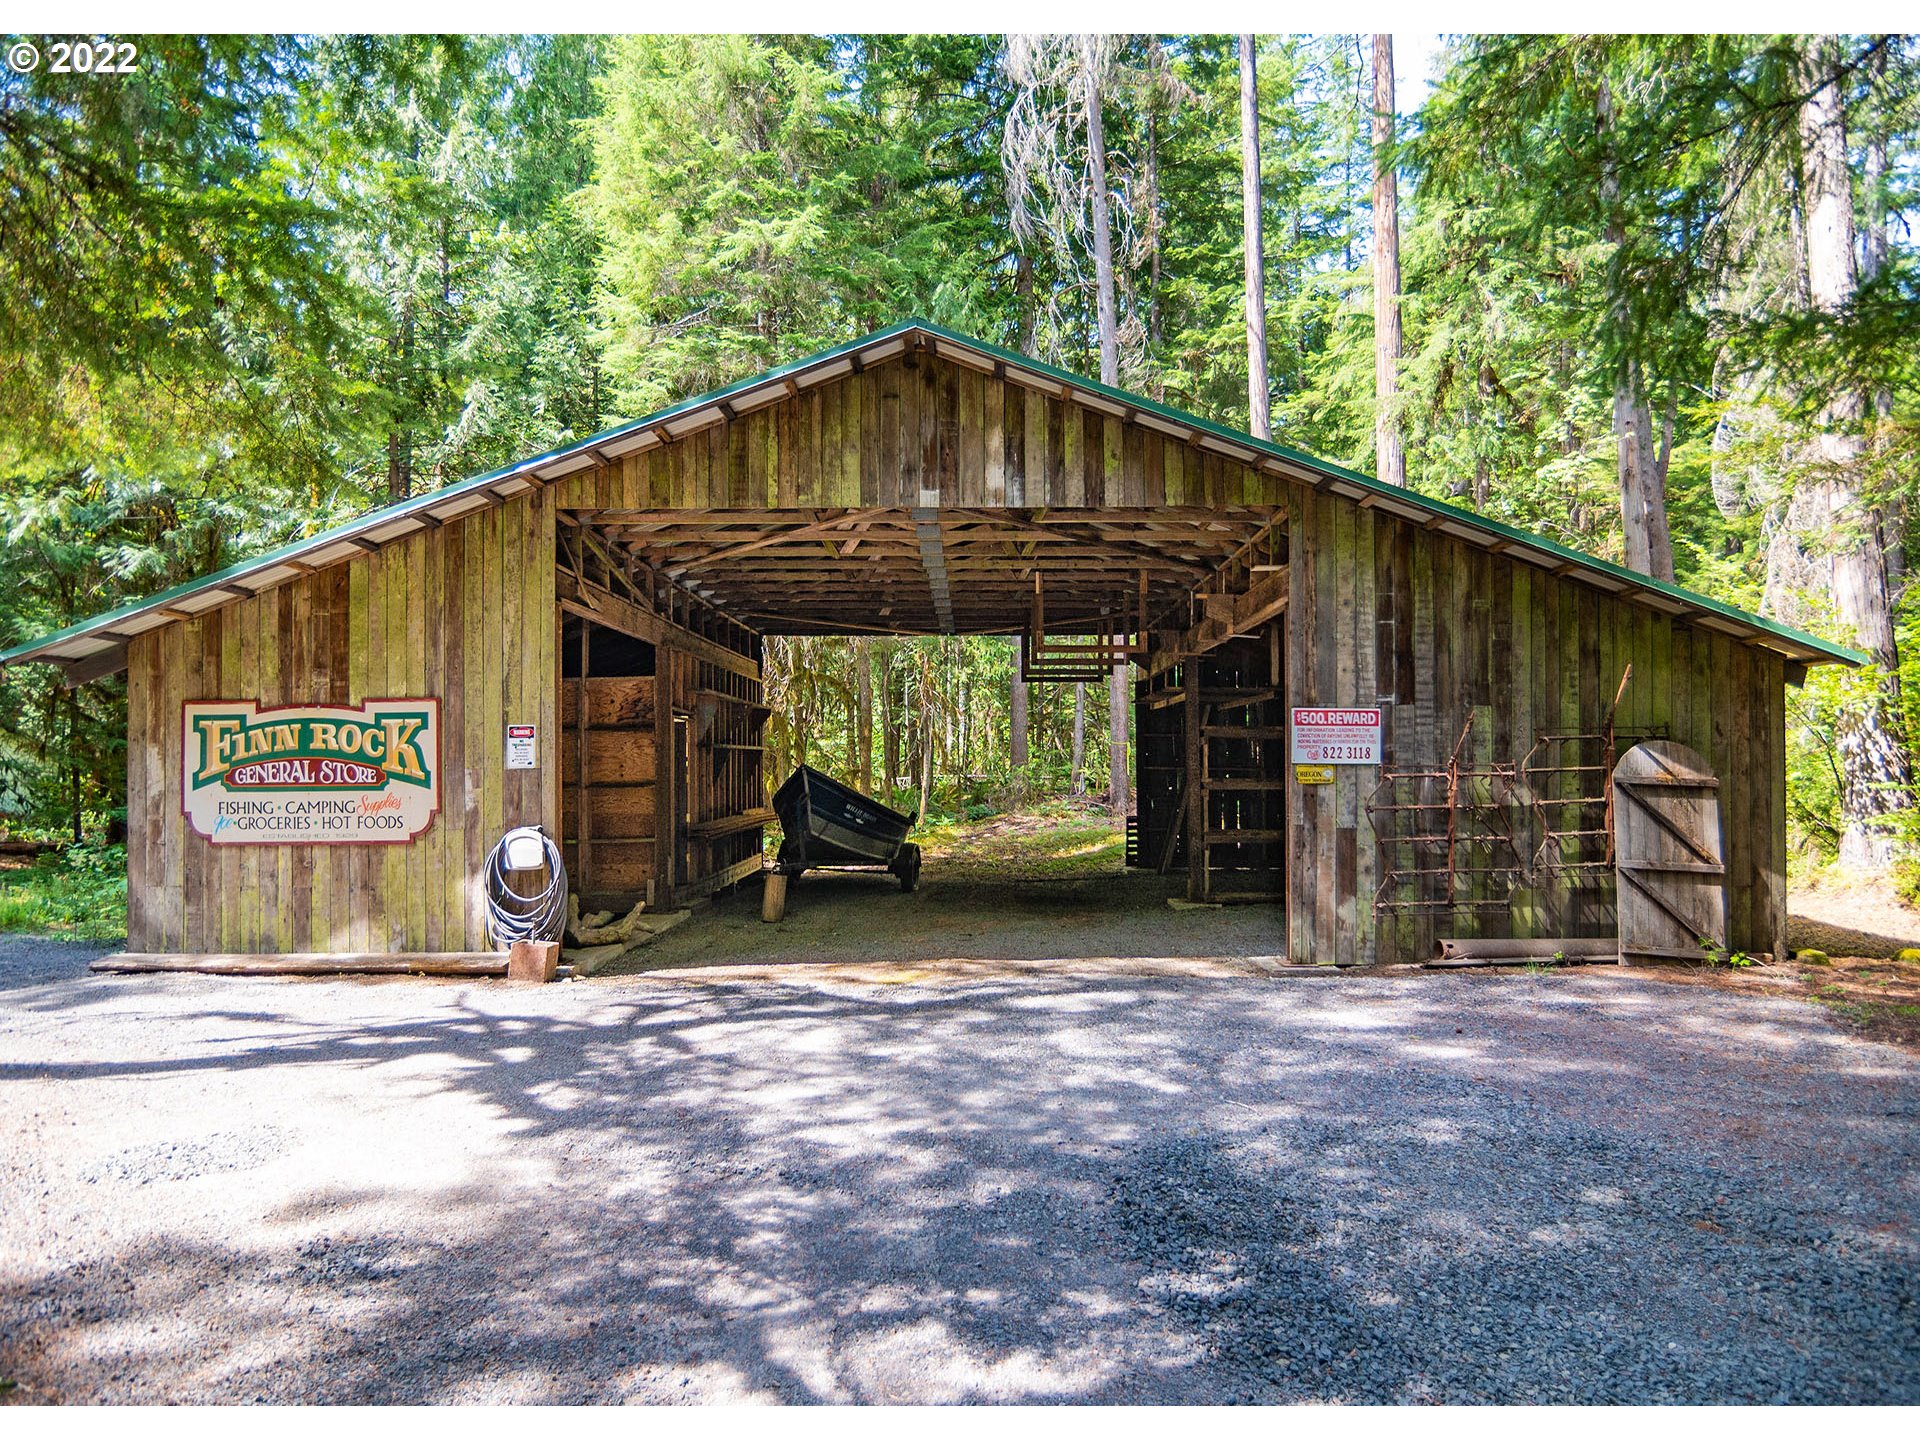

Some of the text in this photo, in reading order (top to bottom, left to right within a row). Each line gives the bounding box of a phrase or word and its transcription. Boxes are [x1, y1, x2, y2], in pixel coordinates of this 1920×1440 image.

[1328, 711, 1376, 725] REWARD
[199, 718, 425, 781] FINN ROCK
[1323, 747, 1342, 759] 822
[1346, 747, 1371, 759] 3118
[234, 760, 377, 784] GENERAL STORE
[218, 792, 402, 817] FISHING CAMPING Supplies
[237, 816, 311, 830] GROCERIES
[322, 816, 351, 829] HOT
[357, 815, 404, 829] FOODS
